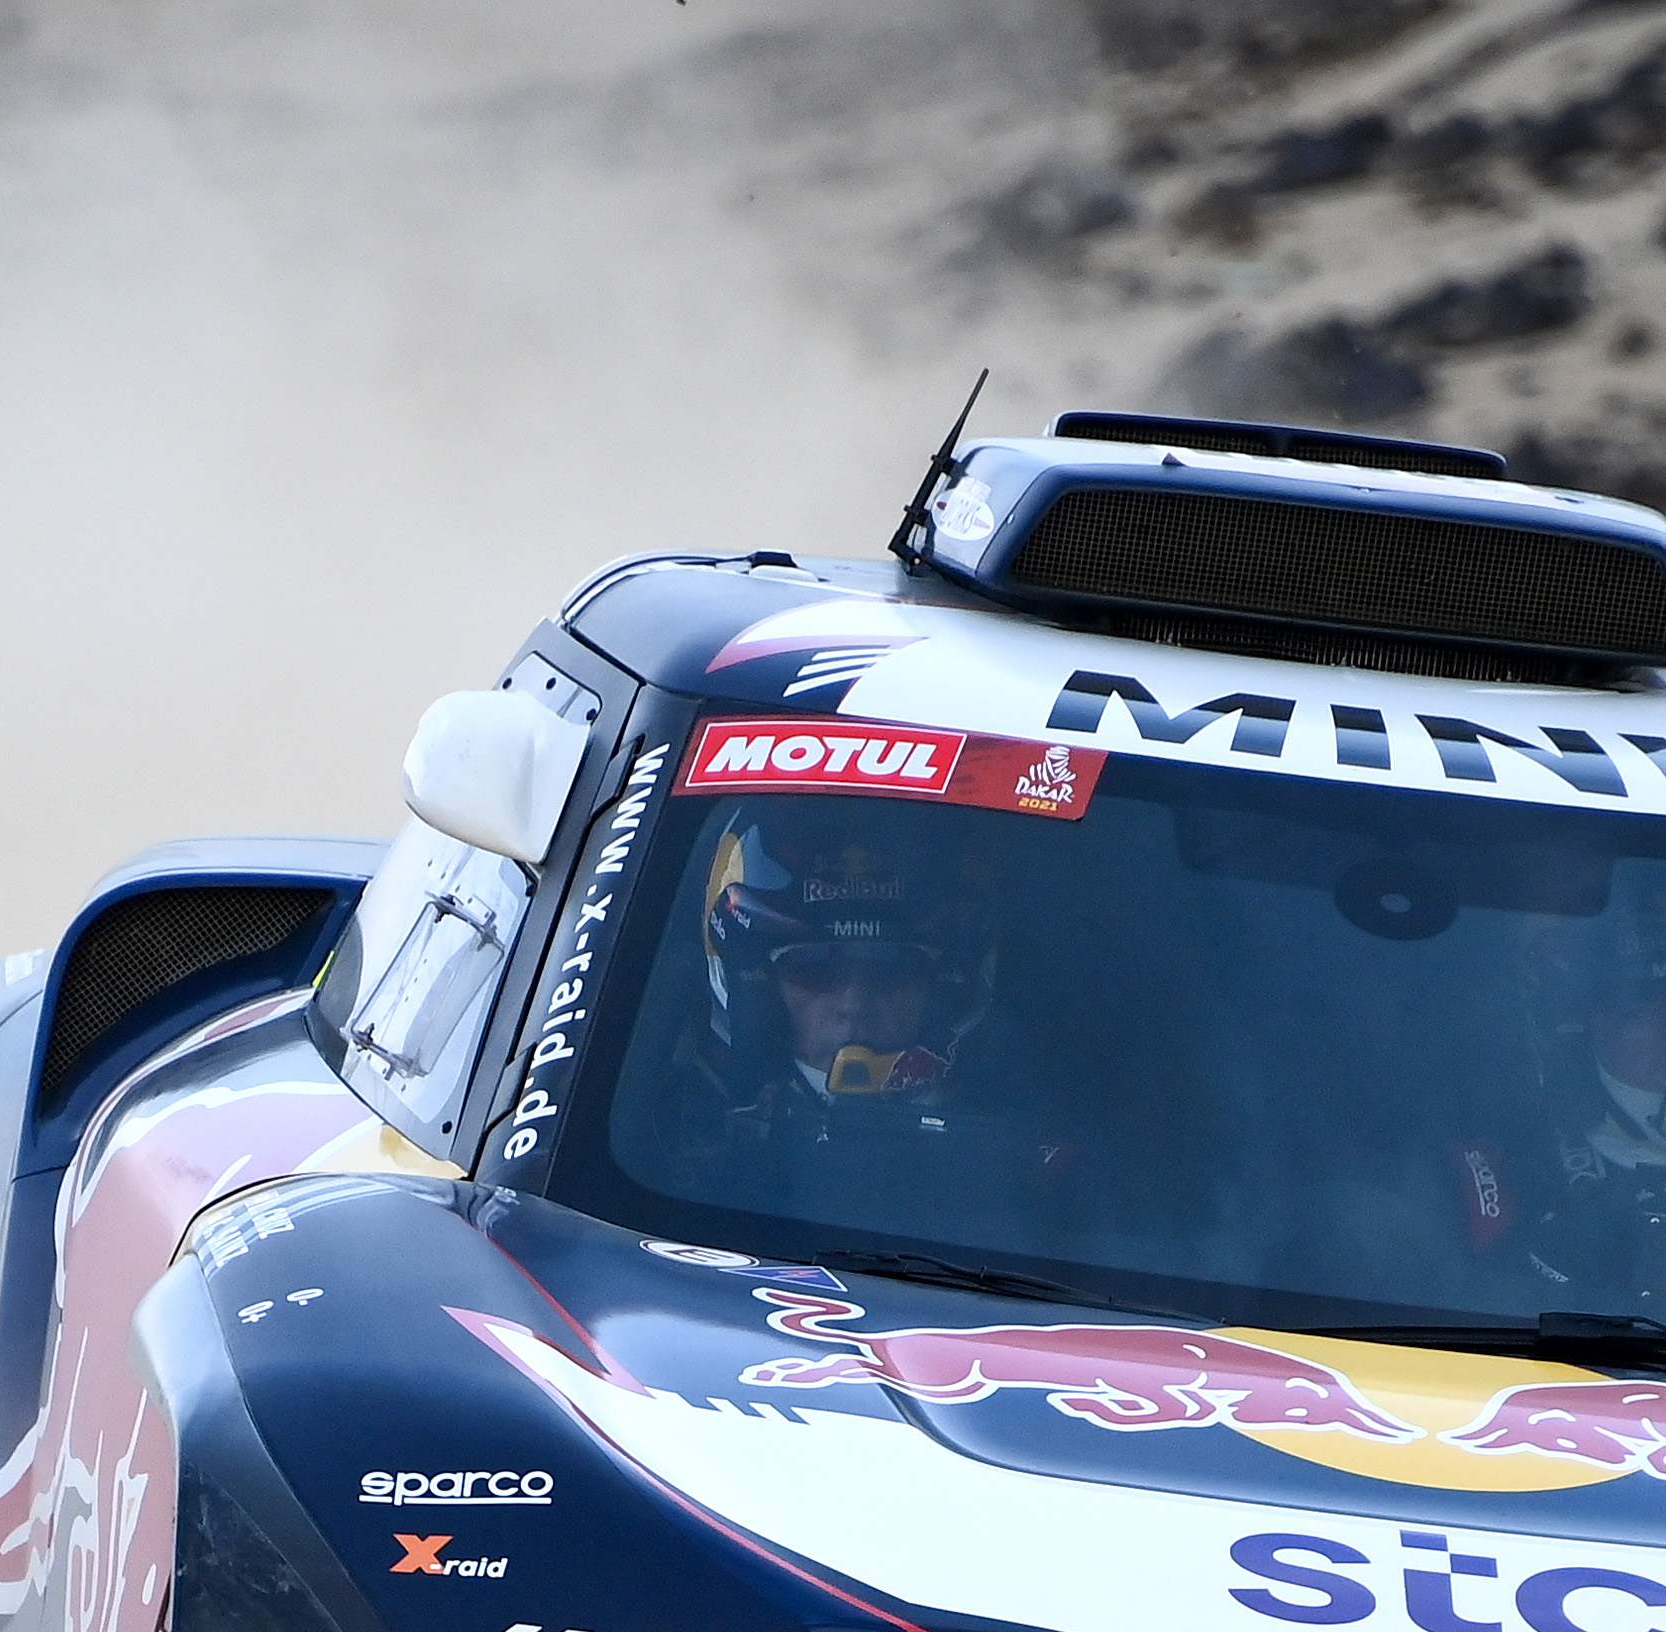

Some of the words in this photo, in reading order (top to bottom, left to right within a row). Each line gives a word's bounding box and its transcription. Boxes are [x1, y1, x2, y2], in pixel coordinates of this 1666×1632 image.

[704, 735, 939, 780] MOTUL
[1014, 775, 1074, 804] DAKAR
[1017, 797, 1059, 812] 2021
[834, 919, 881, 937] MINI
[503, 743, 671, 1160] www.x-raid.de
[360, 1470, 554, 1506] sparco
[389, 1533, 509, 1579] X-raid
